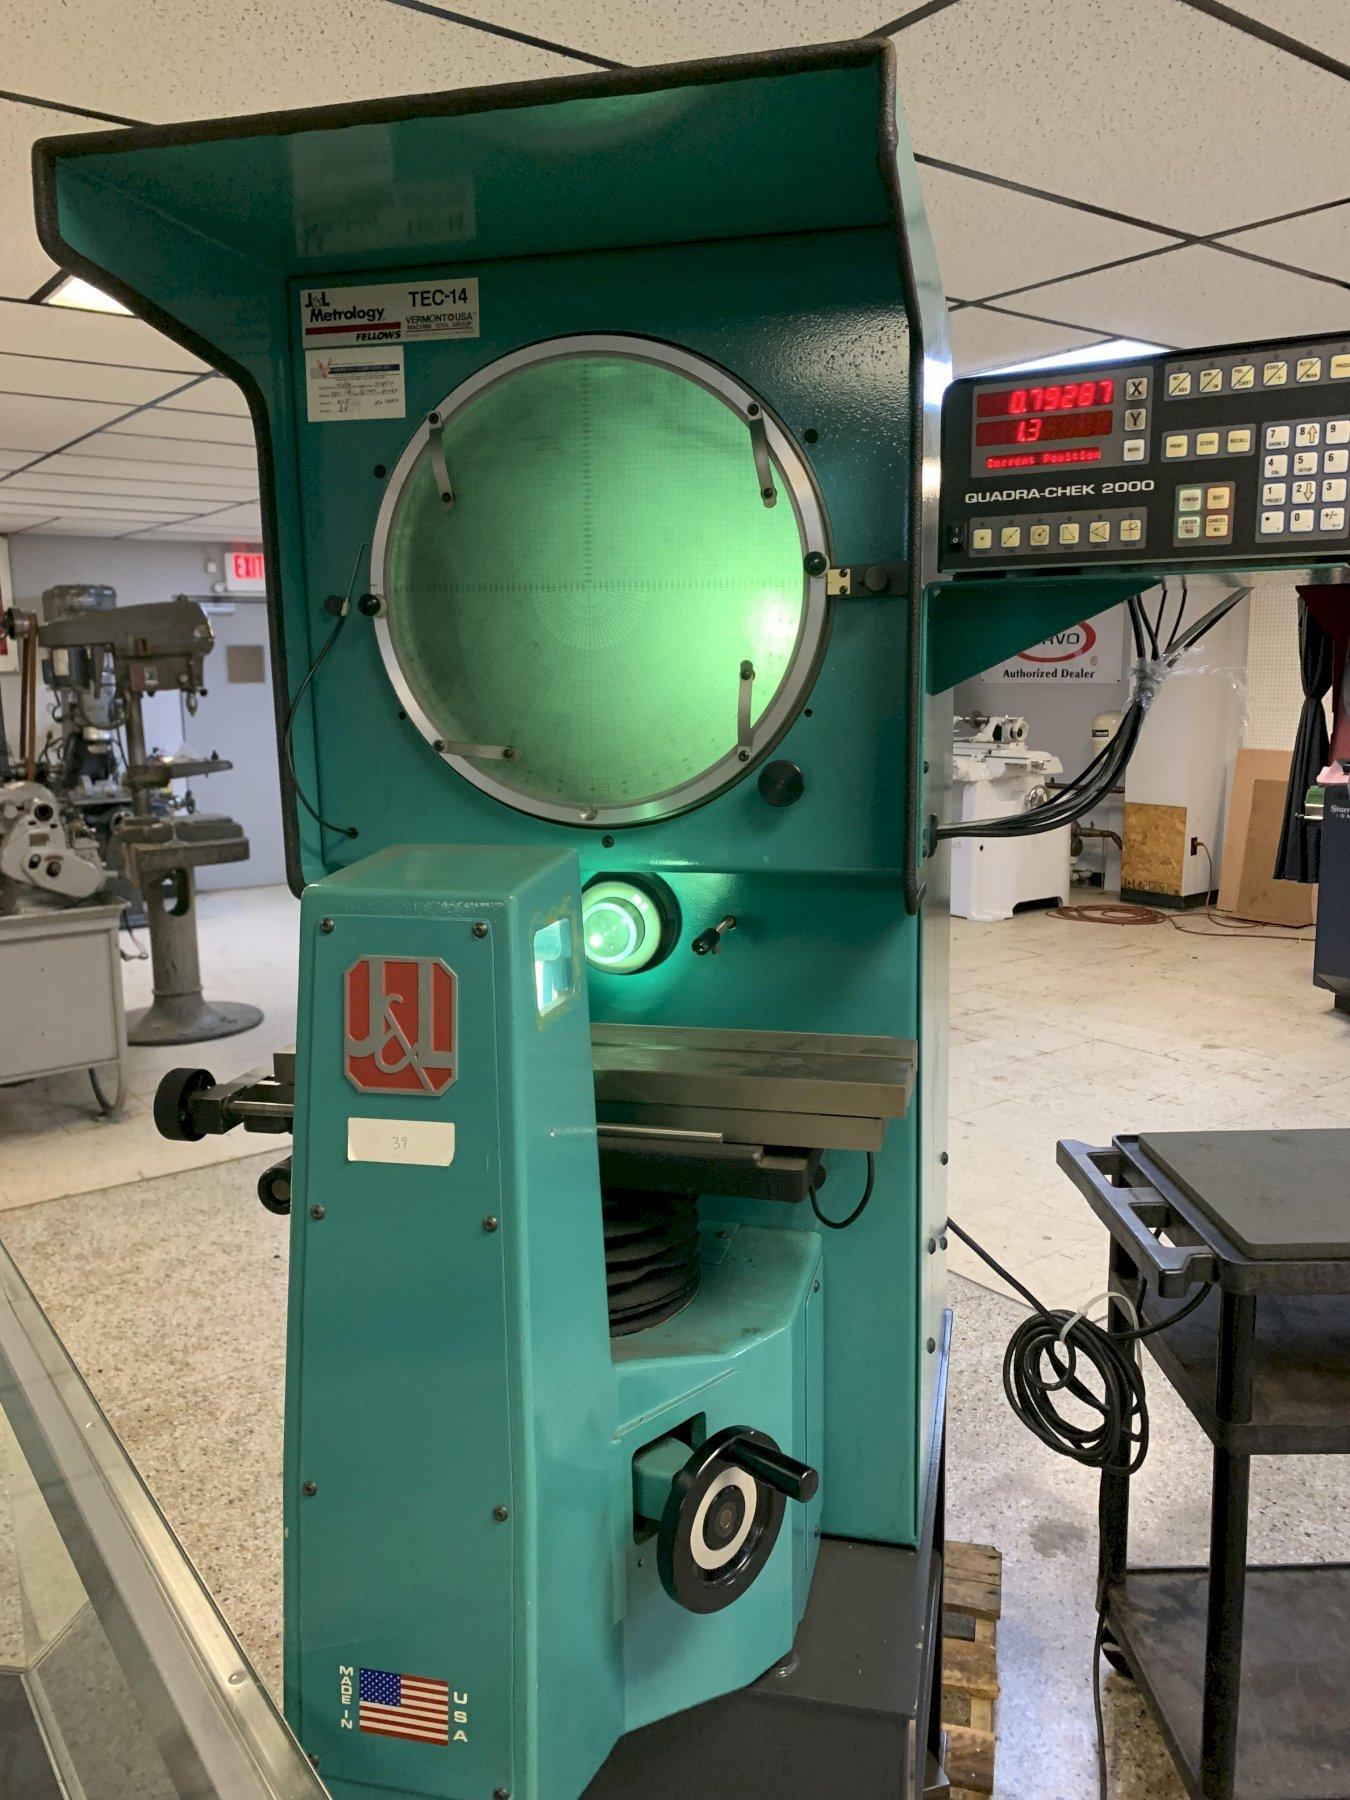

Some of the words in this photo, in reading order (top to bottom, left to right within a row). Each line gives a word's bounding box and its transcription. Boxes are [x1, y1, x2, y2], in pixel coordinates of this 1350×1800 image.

[408, 288, 468, 307] TEC-14
[310, 305, 385, 323] Metrology
[356, 330, 401, 341] FELLOWS
[1131, 381, 1143, 396] X
[1130, 412, 1141, 426] Y
[1270, 429, 1276, 439] 7
[1300, 426, 1306, 436] 8
[1330, 424, 1337, 433] 9
[986, 456, 1036, 469] Current
[1043, 450, 1102, 464] Position
[1268, 458, 1274, 467] 4
[1298, 455, 1304, 465] 5
[1328, 453, 1334, 462] 6
[965, 484, 1095, 503] QUADRA-CHEK
[1102, 480, 1154, 494] 2000
[1296, 484, 1302, 493] 2
[1326, 482, 1332, 491] 3
[1294, 512, 1300, 522] 0
[1003, 668, 1058, 679] Authorized
[1061, 668, 1095, 678] Dealer
[392, 1136, 408, 1150] 39
[339, 1665, 354, 1705] MADE
[340, 1709, 353, 1729] IN
